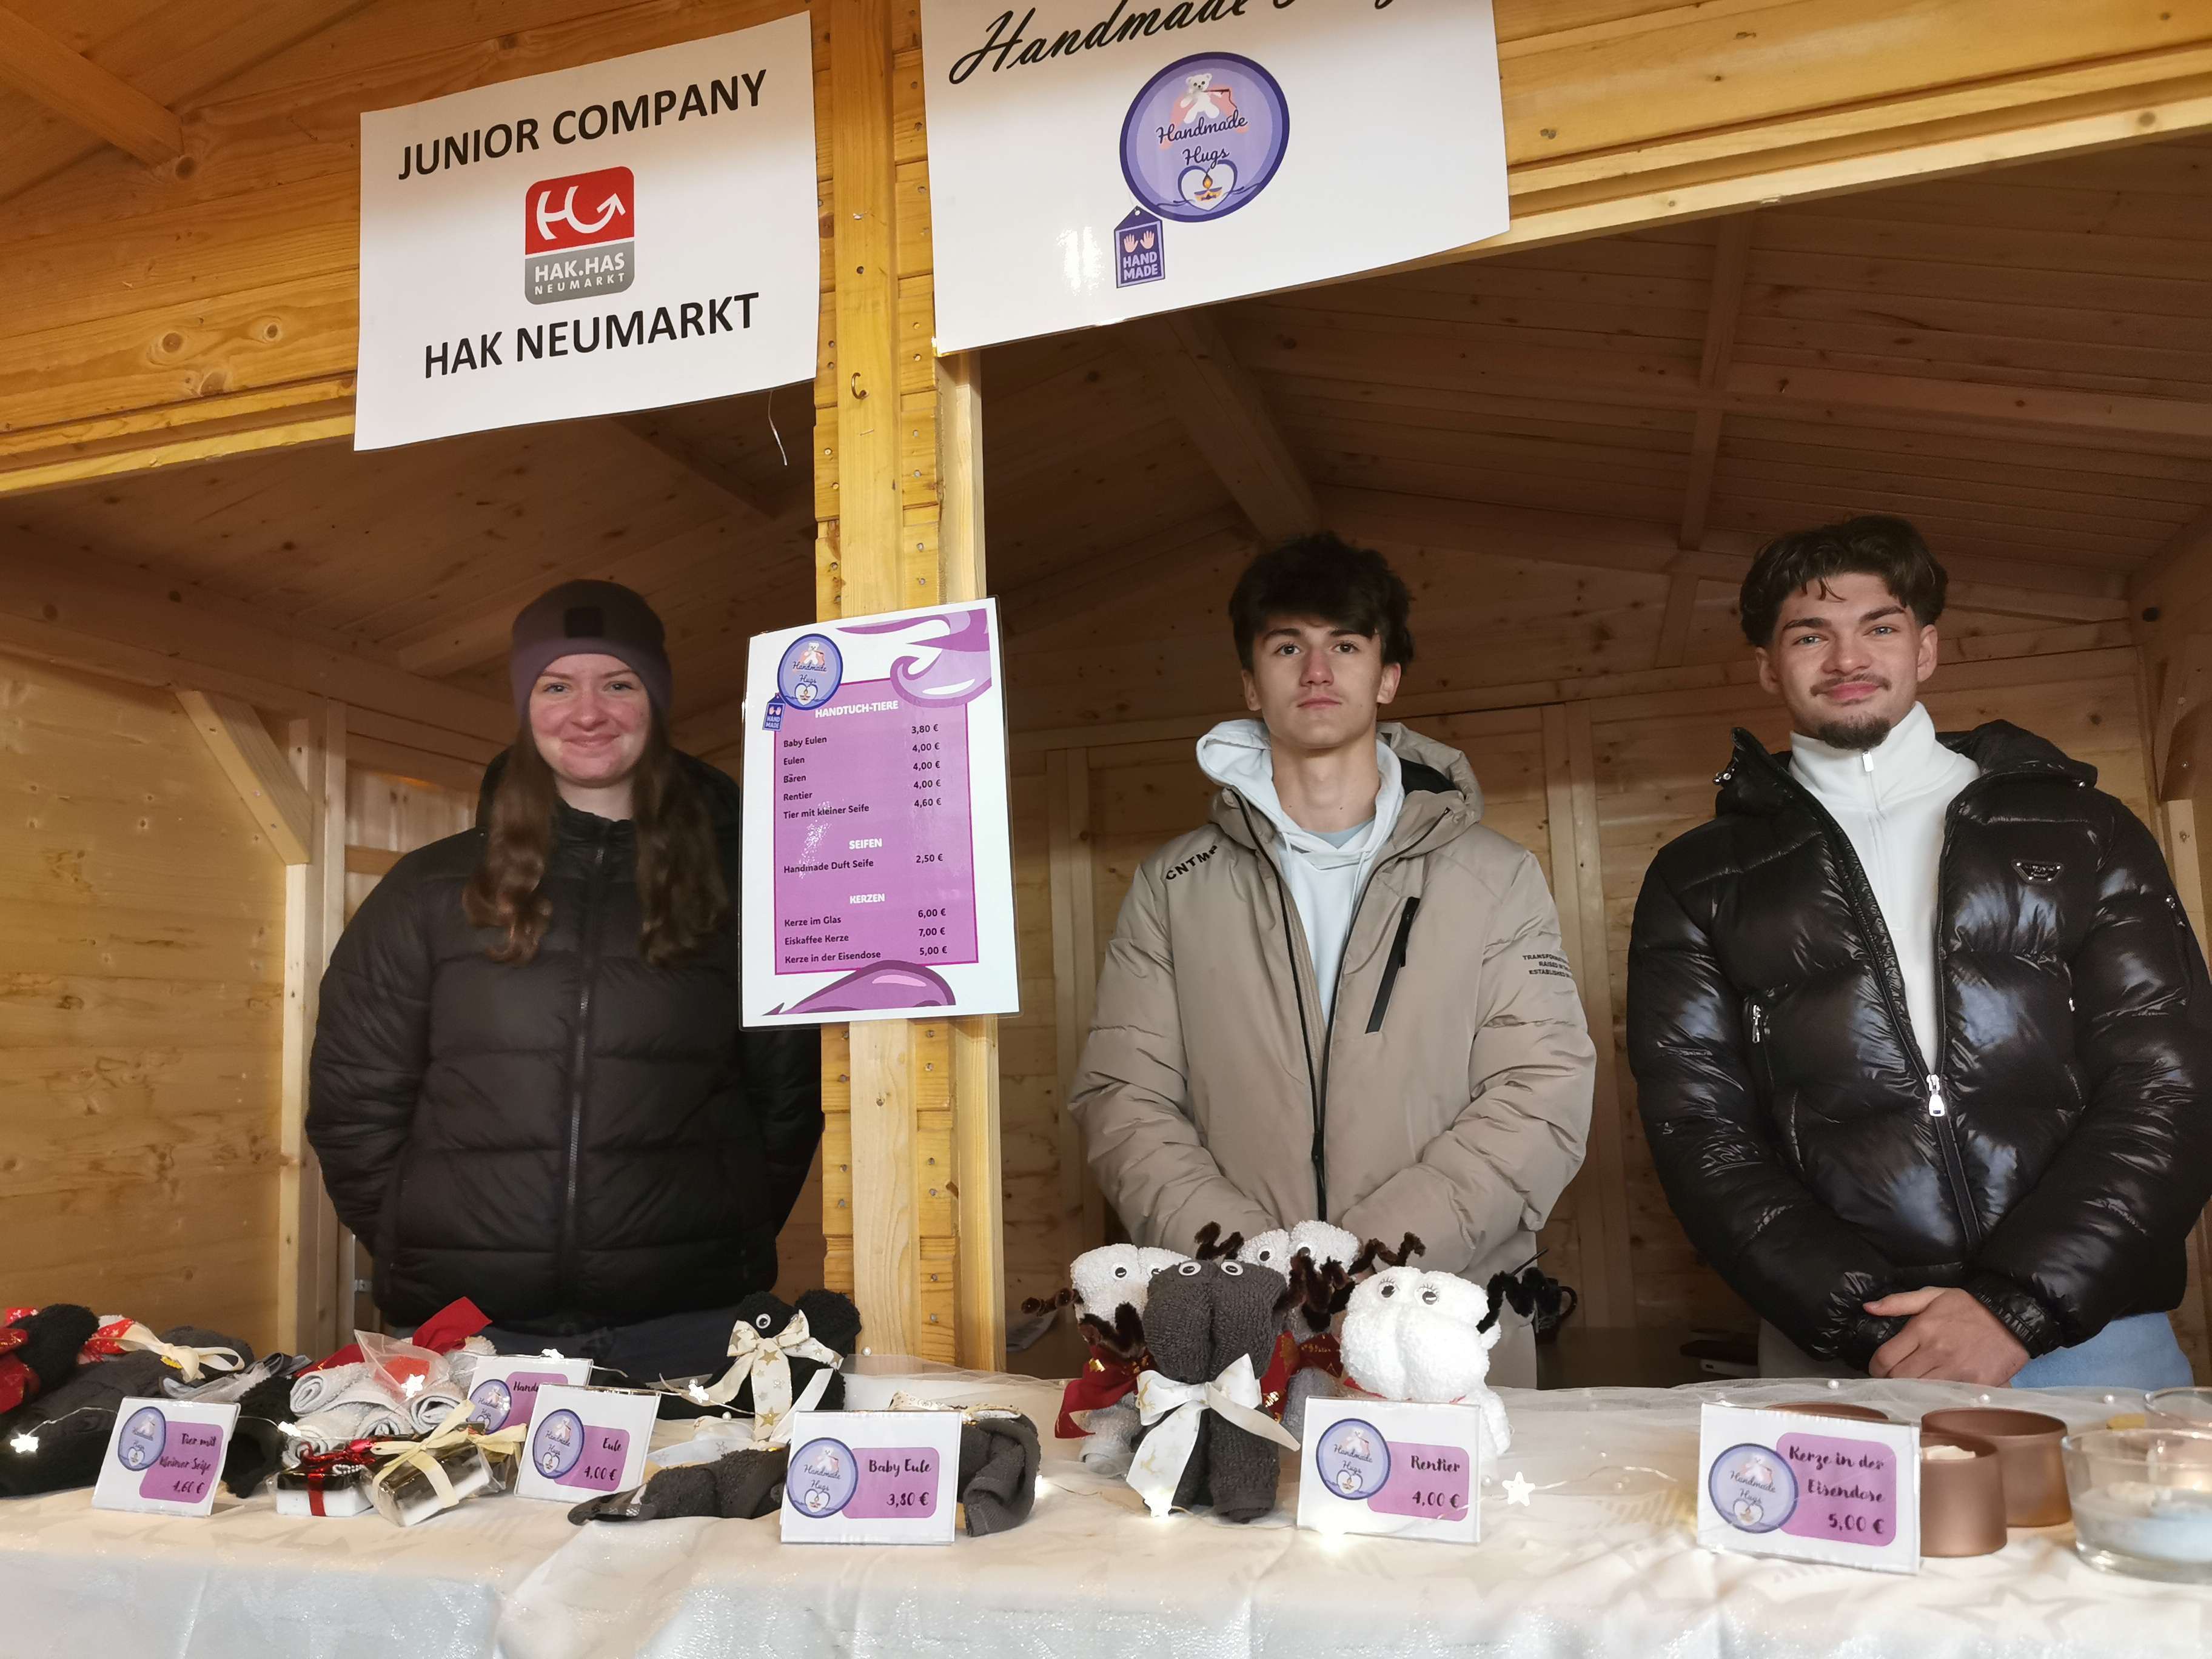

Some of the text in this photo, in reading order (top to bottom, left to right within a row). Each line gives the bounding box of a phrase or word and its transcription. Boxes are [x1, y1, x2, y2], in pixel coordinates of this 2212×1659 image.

[398, 69, 768, 181] JUNIOR COMPANY
[1156, 109, 1248, 144] Handmade
[1182, 146, 1230, 169] Hugs
[534, 251, 625, 284] HAK.HAS
[1123, 251, 1158, 269] HAND
[1123, 264, 1158, 281] MADE
[534, 272, 626, 296] NEUMARKT
[425, 292, 760, 378] HAK NEUMARKT
[792, 661, 827, 672] Handmade
[799, 674, 817, 685] Hugs
[814, 700, 899, 719] HANDTUCH-TIERE
[911, 723, 939, 734] 3,80 €
[783, 736, 827, 748] Baby Eulen
[912, 742, 940, 753] 4,00 €
[783, 756, 805, 766] Eulen
[913, 760, 940, 771] 4,00 €
[783, 773, 806, 783] Bären
[913, 779, 941, 790] 4,00 €
[783, 791, 813, 802] Rentier
[914, 797, 942, 808] 4,60 €
[783, 804, 870, 819] Tier mit kleiner Seife
[849, 838, 882, 850] SEIFEN
[916, 853, 943, 863] 2,50 €
[783, 859, 874, 874] Handmade Duft Seife
[850, 893, 885, 904] KERZEN
[917, 908, 946, 919] 6,00 €
[785, 915, 842, 928] Kerze im Glas
[785, 933, 849, 946] Eiskaffee Kerze
[918, 927, 946, 937] 7,00 €
[785, 950, 881, 964] Kerze in der Eisendose
[919, 945, 948, 956] 5,00 €
[181, 1433, 216, 1447] Tier mit
[602, 1437, 622, 1452] Eule
[1333, 1444, 1373, 1463] Handmade
[1789, 1445, 1884, 1470] Kerze in der
[869, 1458, 932, 1478] Baby Eule
[1343, 1460, 1362, 1475] Hugs
[1410, 1455, 1461, 1473] Rentier
[584, 1465, 617, 1481] 4,00 €
[804, 1464, 842, 1480] Handmade
[810, 1479, 830, 1493] Hugs
[1729, 1470, 1776, 1494] Handmade
[1740, 1488, 1763, 1506] Hugs
[1808, 1479, 1885, 1503] Eisendose
[886, 1492, 930, 1509] 3,80 €
[1412, 1490, 1461, 1508] 4,00 €
[1828, 1513, 1885, 1535] 5,00 €
